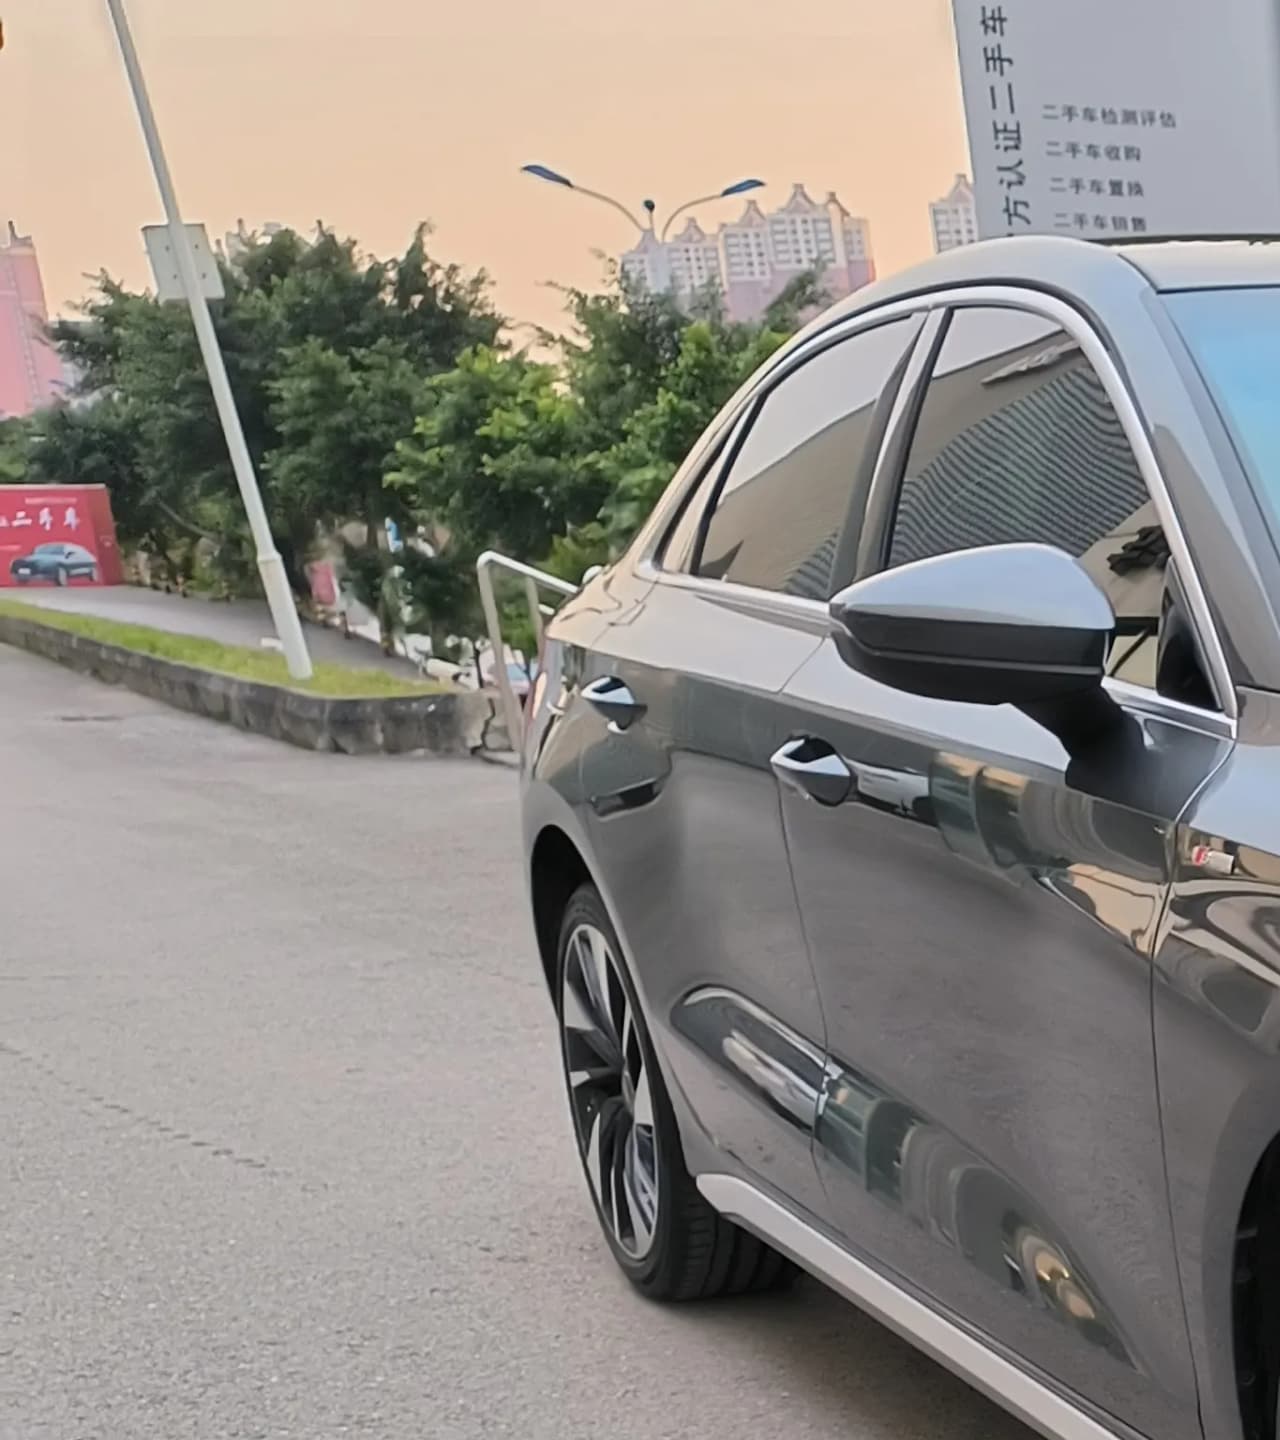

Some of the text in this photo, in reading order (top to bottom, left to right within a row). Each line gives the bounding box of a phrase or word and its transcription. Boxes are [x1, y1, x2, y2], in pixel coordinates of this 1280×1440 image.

[980, 5, 1031, 238] 方认证二手车
